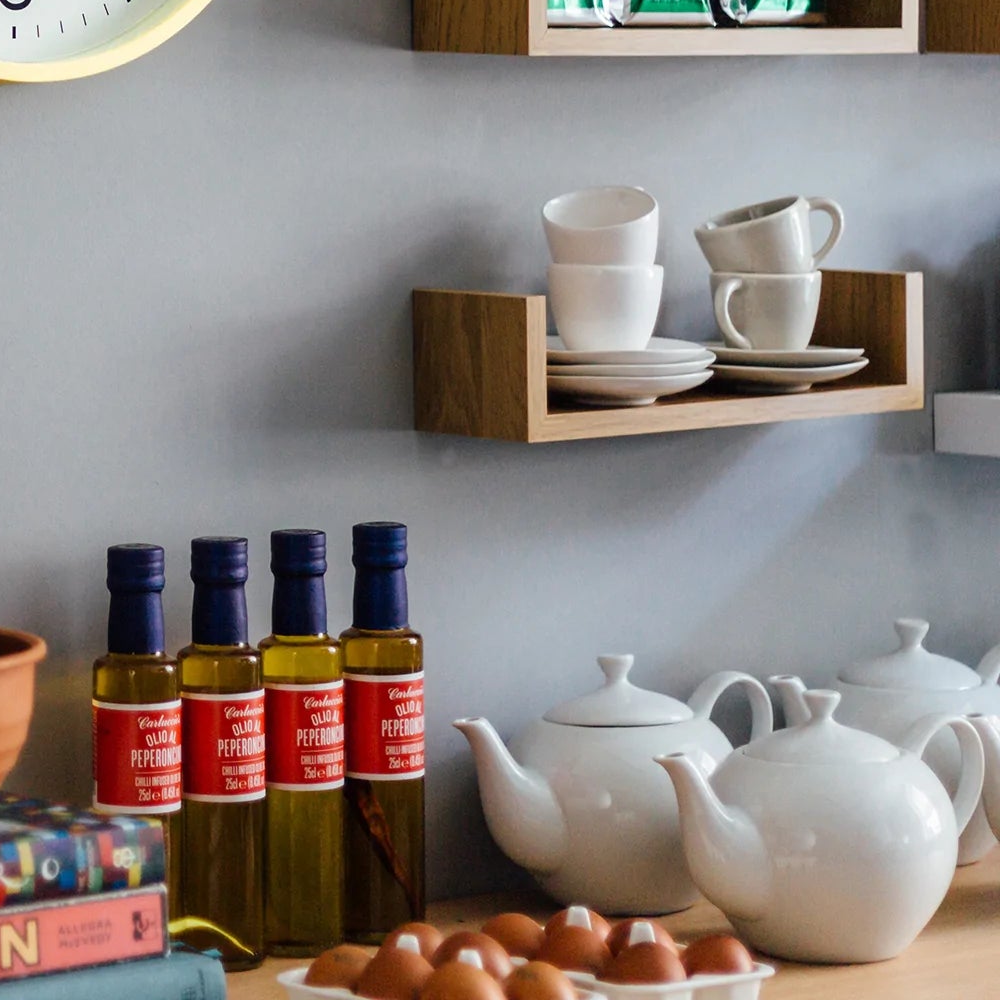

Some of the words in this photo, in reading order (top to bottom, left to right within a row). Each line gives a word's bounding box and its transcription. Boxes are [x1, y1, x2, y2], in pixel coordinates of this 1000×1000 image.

[311, 710, 331, 726] OLIO
[331, 709, 340, 723] AL
[395, 701, 415, 717] OLIO
[415, 701, 422, 713] AL
[232, 719, 253, 736] OLIO
[253, 719, 262, 733] AL
[145, 729, 168, 747] OLIO
[168, 730, 177, 744] AL
